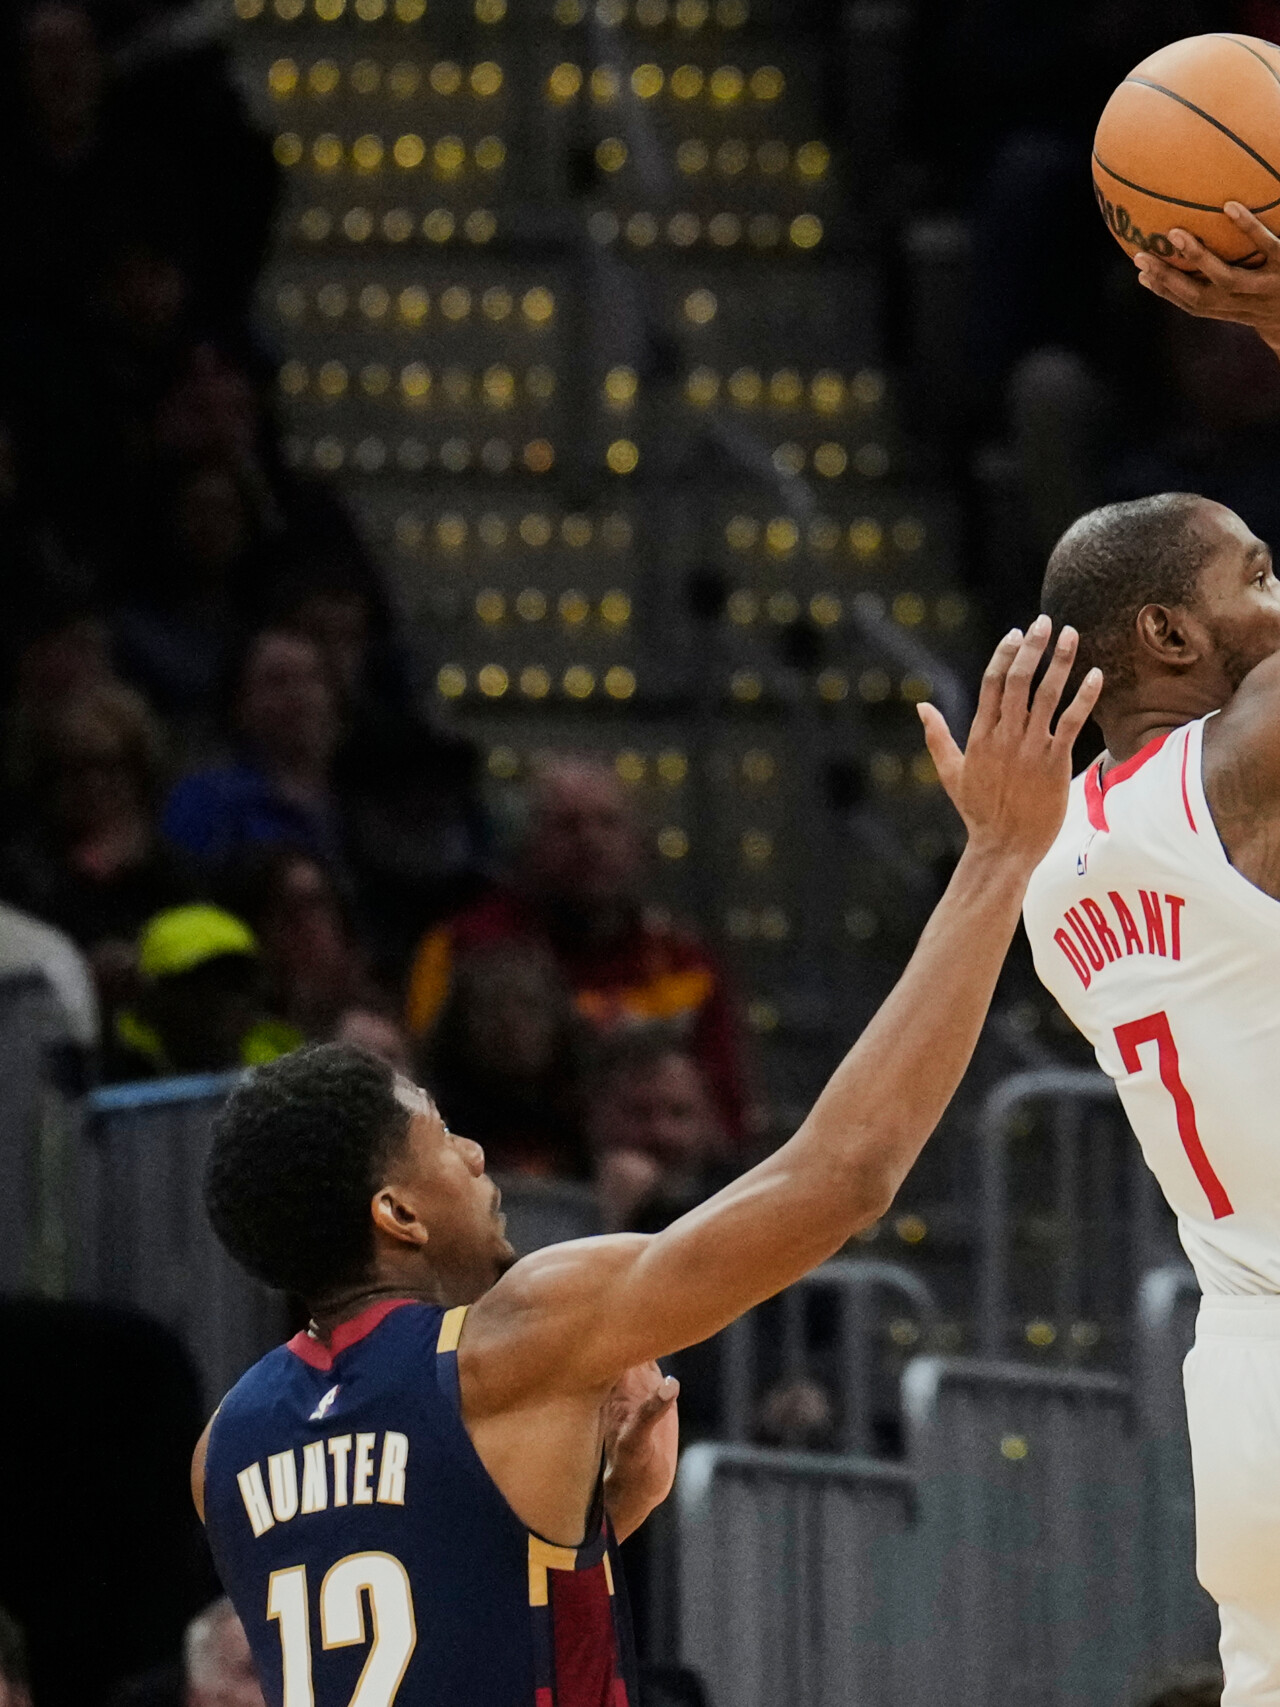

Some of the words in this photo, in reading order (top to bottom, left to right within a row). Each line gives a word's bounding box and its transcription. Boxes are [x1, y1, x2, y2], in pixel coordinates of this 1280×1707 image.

[1053, 889, 1186, 991] DURANT
[1113, 1011, 1235, 1220] 7
[237, 1430, 410, 1538] HUNTER
[266, 1550, 417, 1707] 12
